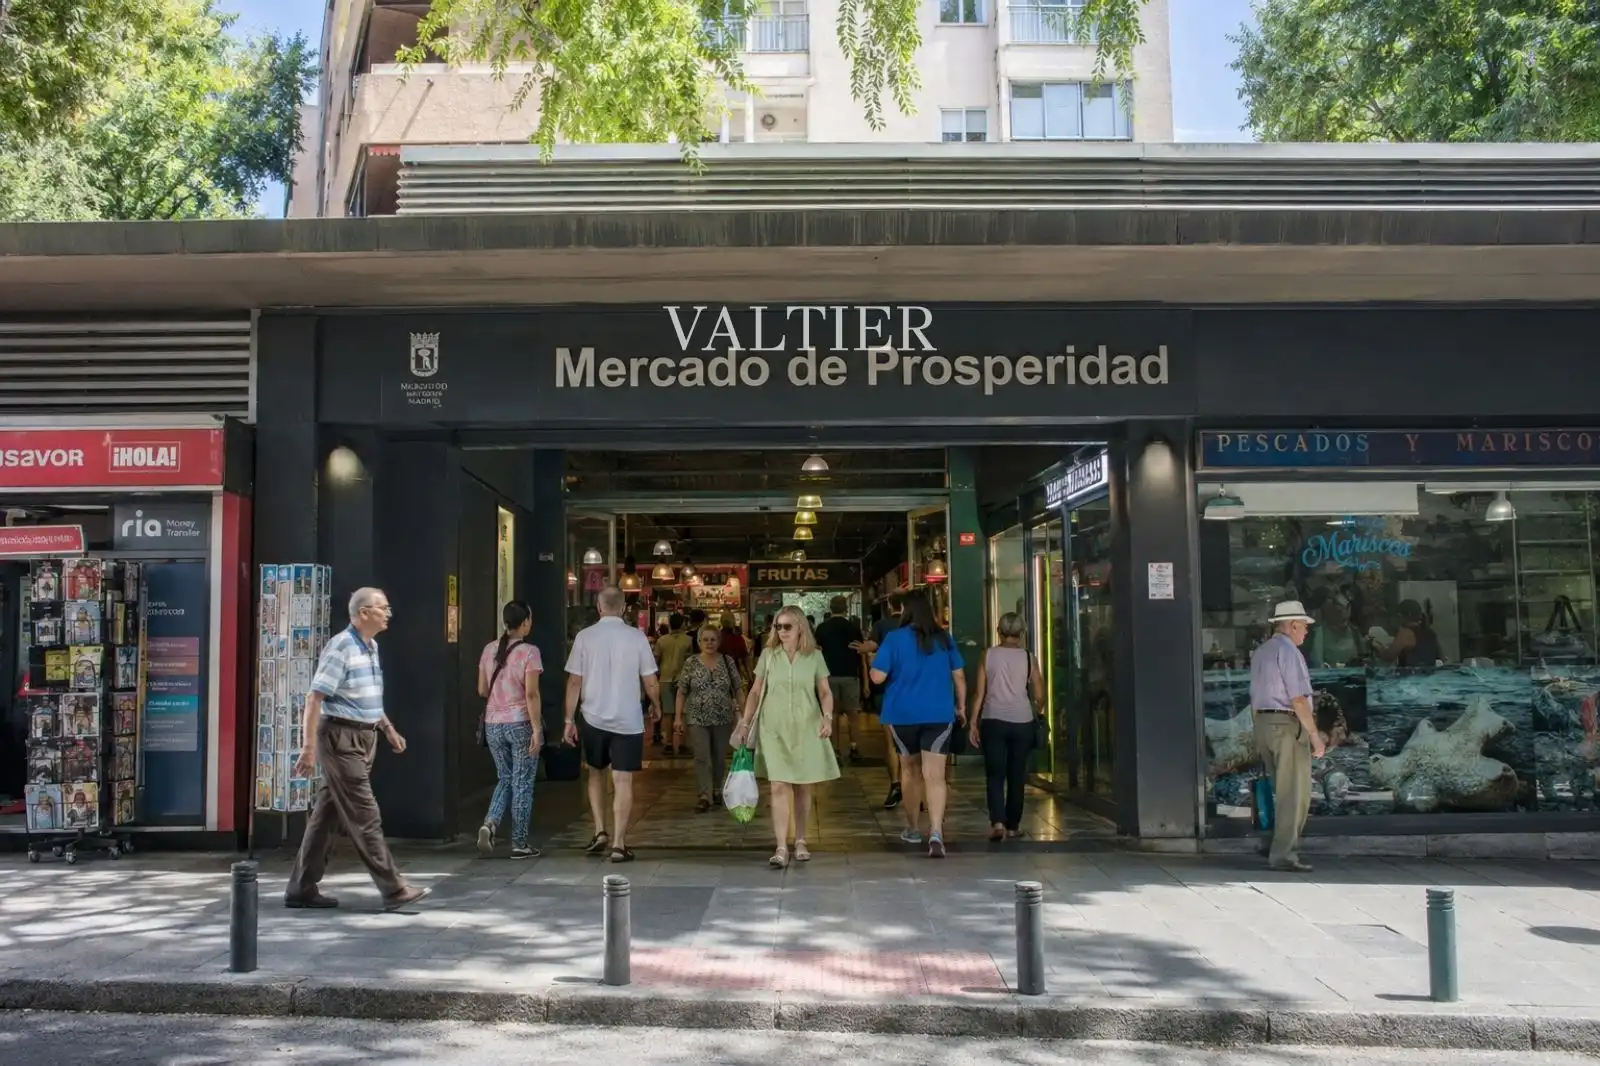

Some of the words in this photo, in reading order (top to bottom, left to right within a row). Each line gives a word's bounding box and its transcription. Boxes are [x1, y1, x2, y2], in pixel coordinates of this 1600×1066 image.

[554, 346, 770, 388] Mercado
[787, 346, 848, 387] de
[867, 345, 1169, 396] Prosperidad
[1216, 433, 1370, 452] PESCADOS
[1405, 433, 1420, 451] Y
[1456, 432, 1600, 452] MARISCO
[113, 446, 177, 467] ¡HOLA!
[121, 509, 162, 537] ria
[166, 519, 196, 529] Money
[166, 529, 201, 537] Transfer
[757, 566, 829, 581] FRUTAS
